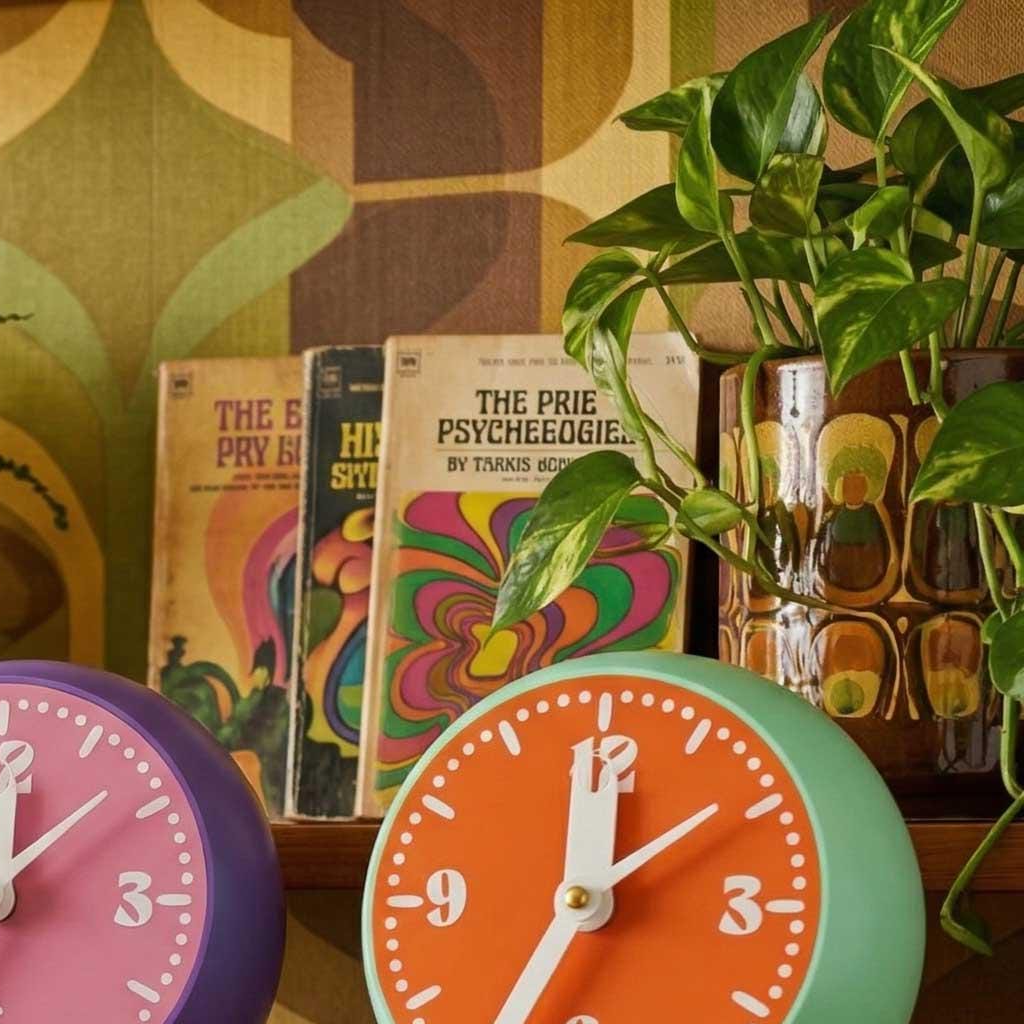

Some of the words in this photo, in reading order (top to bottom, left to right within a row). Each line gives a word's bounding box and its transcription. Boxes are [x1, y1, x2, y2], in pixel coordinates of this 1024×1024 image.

[214, 399, 274, 431] THE
[476, 389, 527, 416] THE
[537, 389, 597, 416] PRIE
[216, 435, 270, 468] PRY
[447, 456, 468, 473] BY
[473, 456, 532, 473] TARKIS
[569, 734, 638, 794] 12
[114, 871, 154, 927] 3
[426, 869, 468, 928] 9
[718, 875, 763, 936] 3
